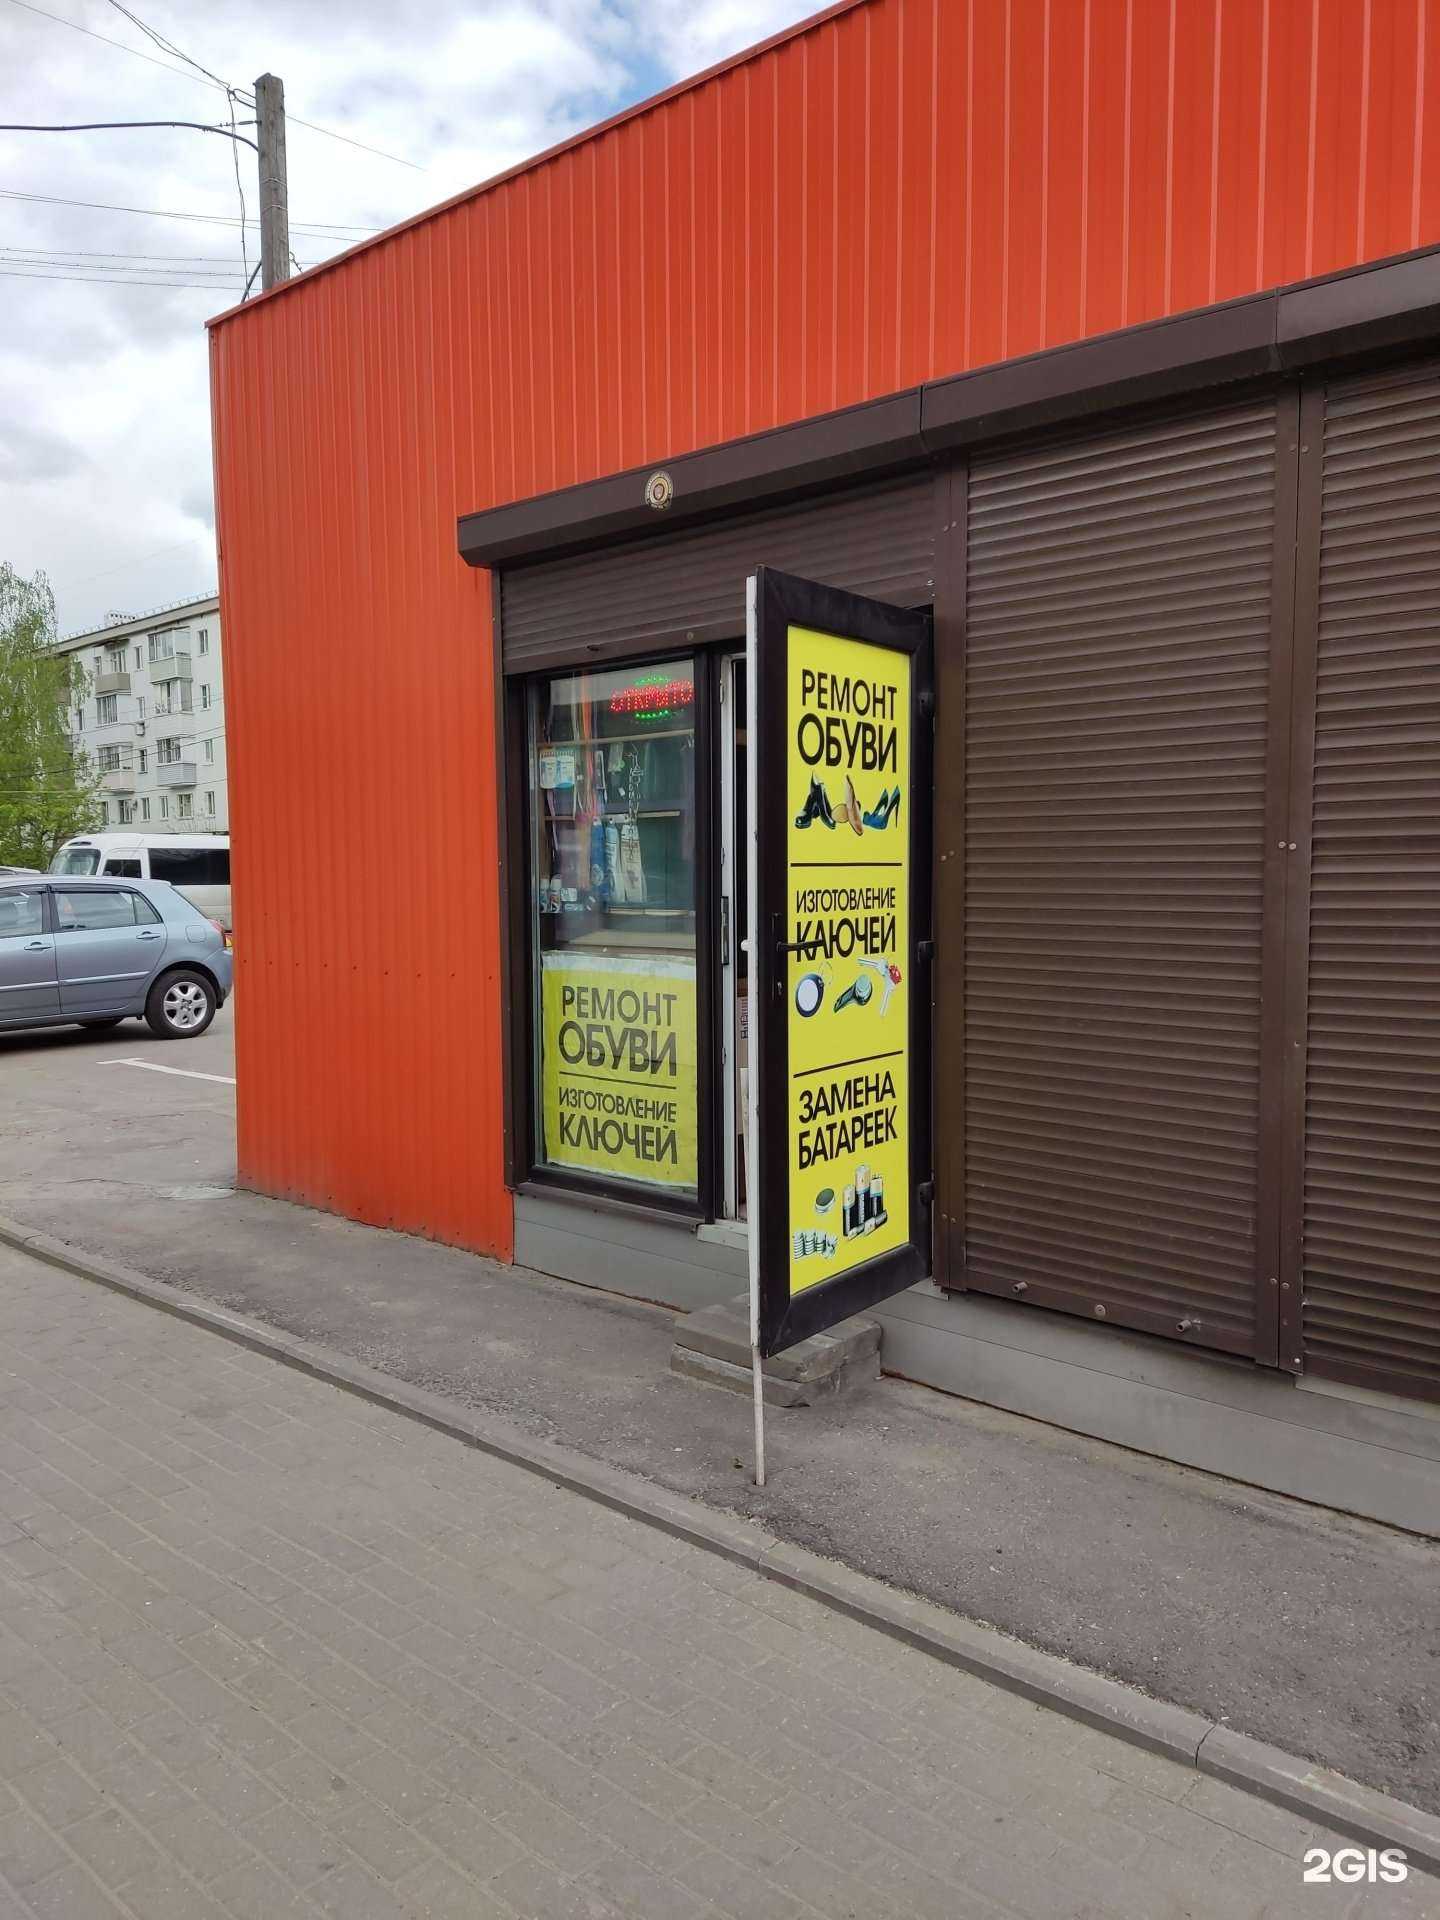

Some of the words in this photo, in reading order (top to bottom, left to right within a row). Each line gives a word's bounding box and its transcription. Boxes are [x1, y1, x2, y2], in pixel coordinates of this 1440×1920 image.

[802, 669, 897, 720] РЕМОНТ
[797, 713, 897, 773] ОБУВИ
[796, 887, 896, 914] ИЗГОТОВЛЕНИЕ
[796, 912, 896, 962] КЛЮЧЕЙ
[562, 986, 677, 1026] РЕМОНТ
[558, 1020, 677, 1076] ОБУВИ
[559, 1087, 676, 1123] ИЗГОТОВЛЕНИЕ
[798, 1071, 896, 1124] ЗАМЕНА
[559, 1111, 678, 1165] КЛЮЧЕЙ
[798, 1105, 898, 1170] БАТАРЕЕК
